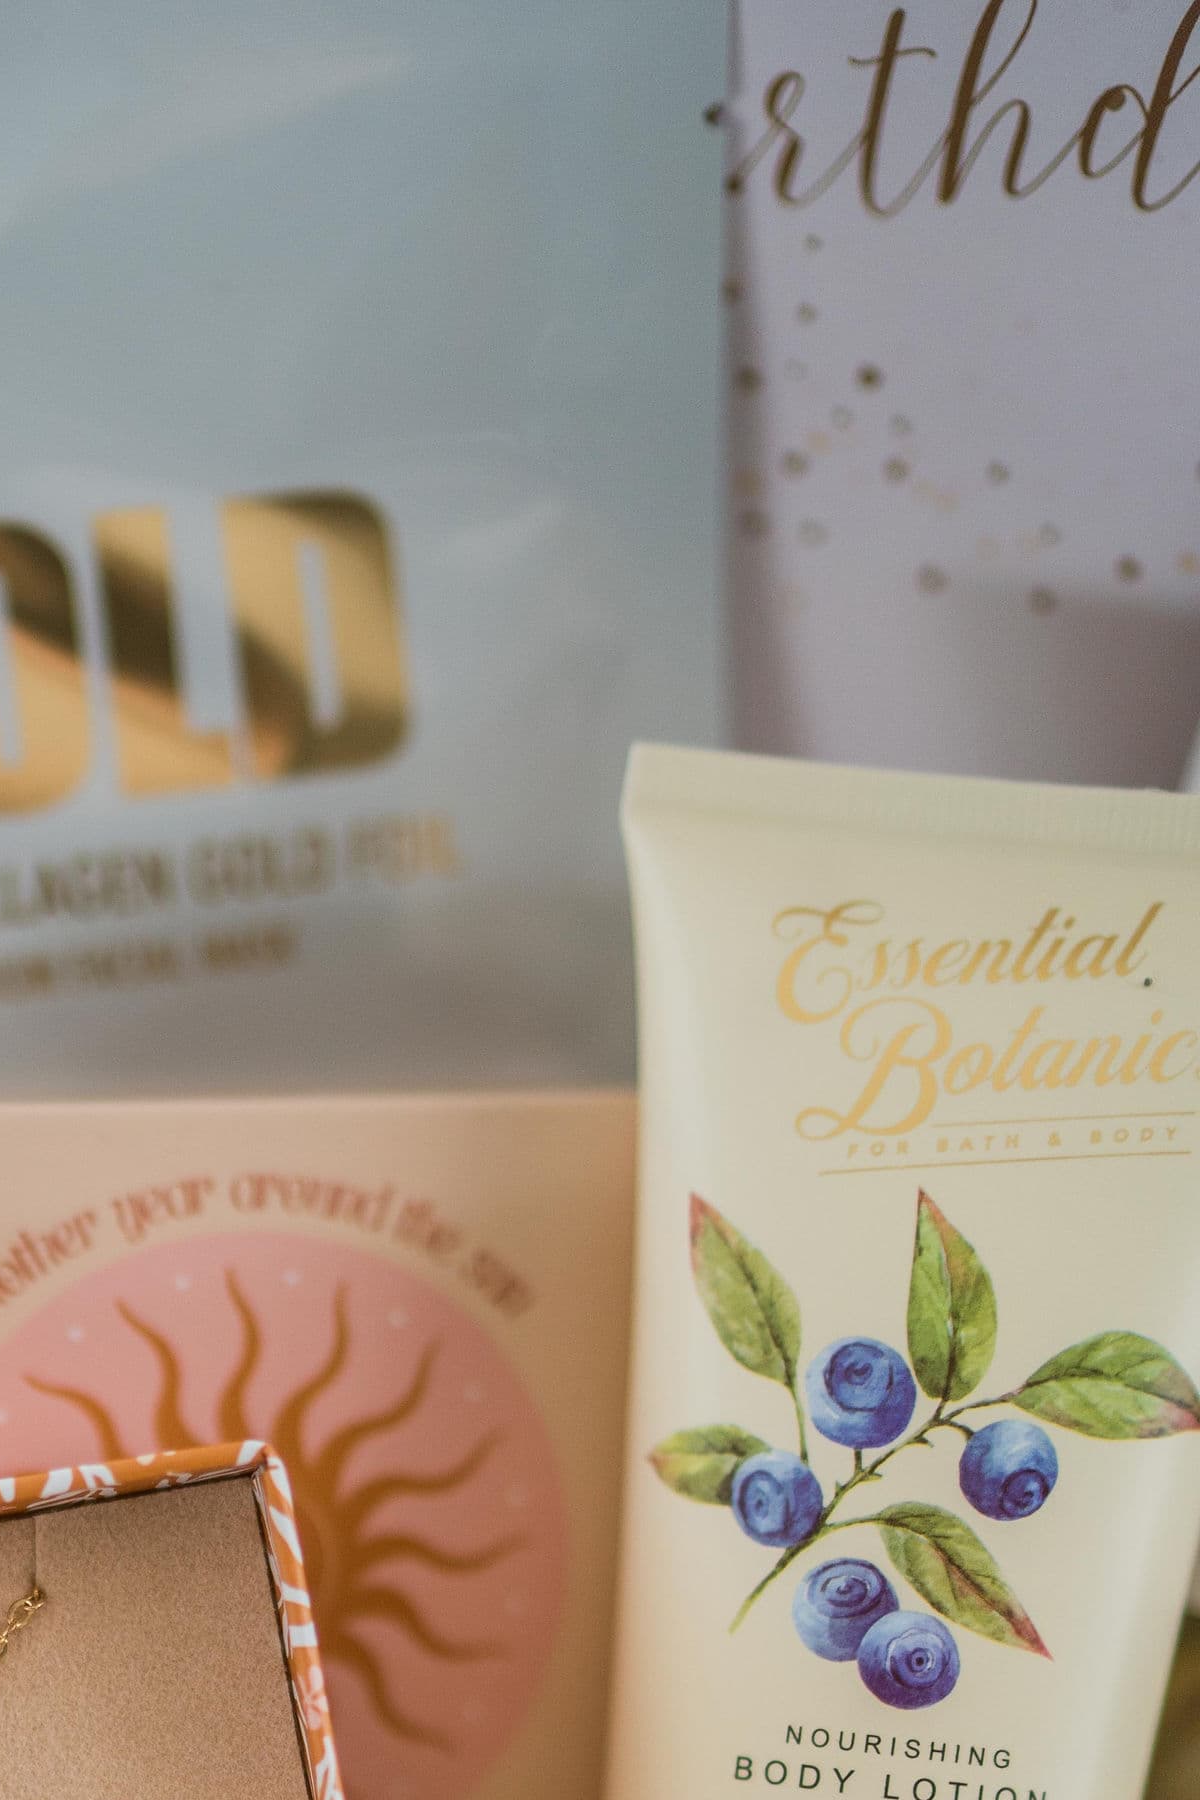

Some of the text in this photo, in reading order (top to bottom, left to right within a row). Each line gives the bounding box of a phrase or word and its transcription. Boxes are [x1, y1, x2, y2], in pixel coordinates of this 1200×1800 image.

[186, 820, 338, 907] GOLD
[772, 899, 1164, 1024] Essential
[795, 996, 1200, 1141] Botanic
[848, 1126, 1177, 1158] FOR BATH & BODY
[111, 1174, 215, 1243] year
[229, 1172, 398, 1233] around
[734, 1756, 855, 1793] BODY
[785, 1725, 1012, 1768] NOURISHING
